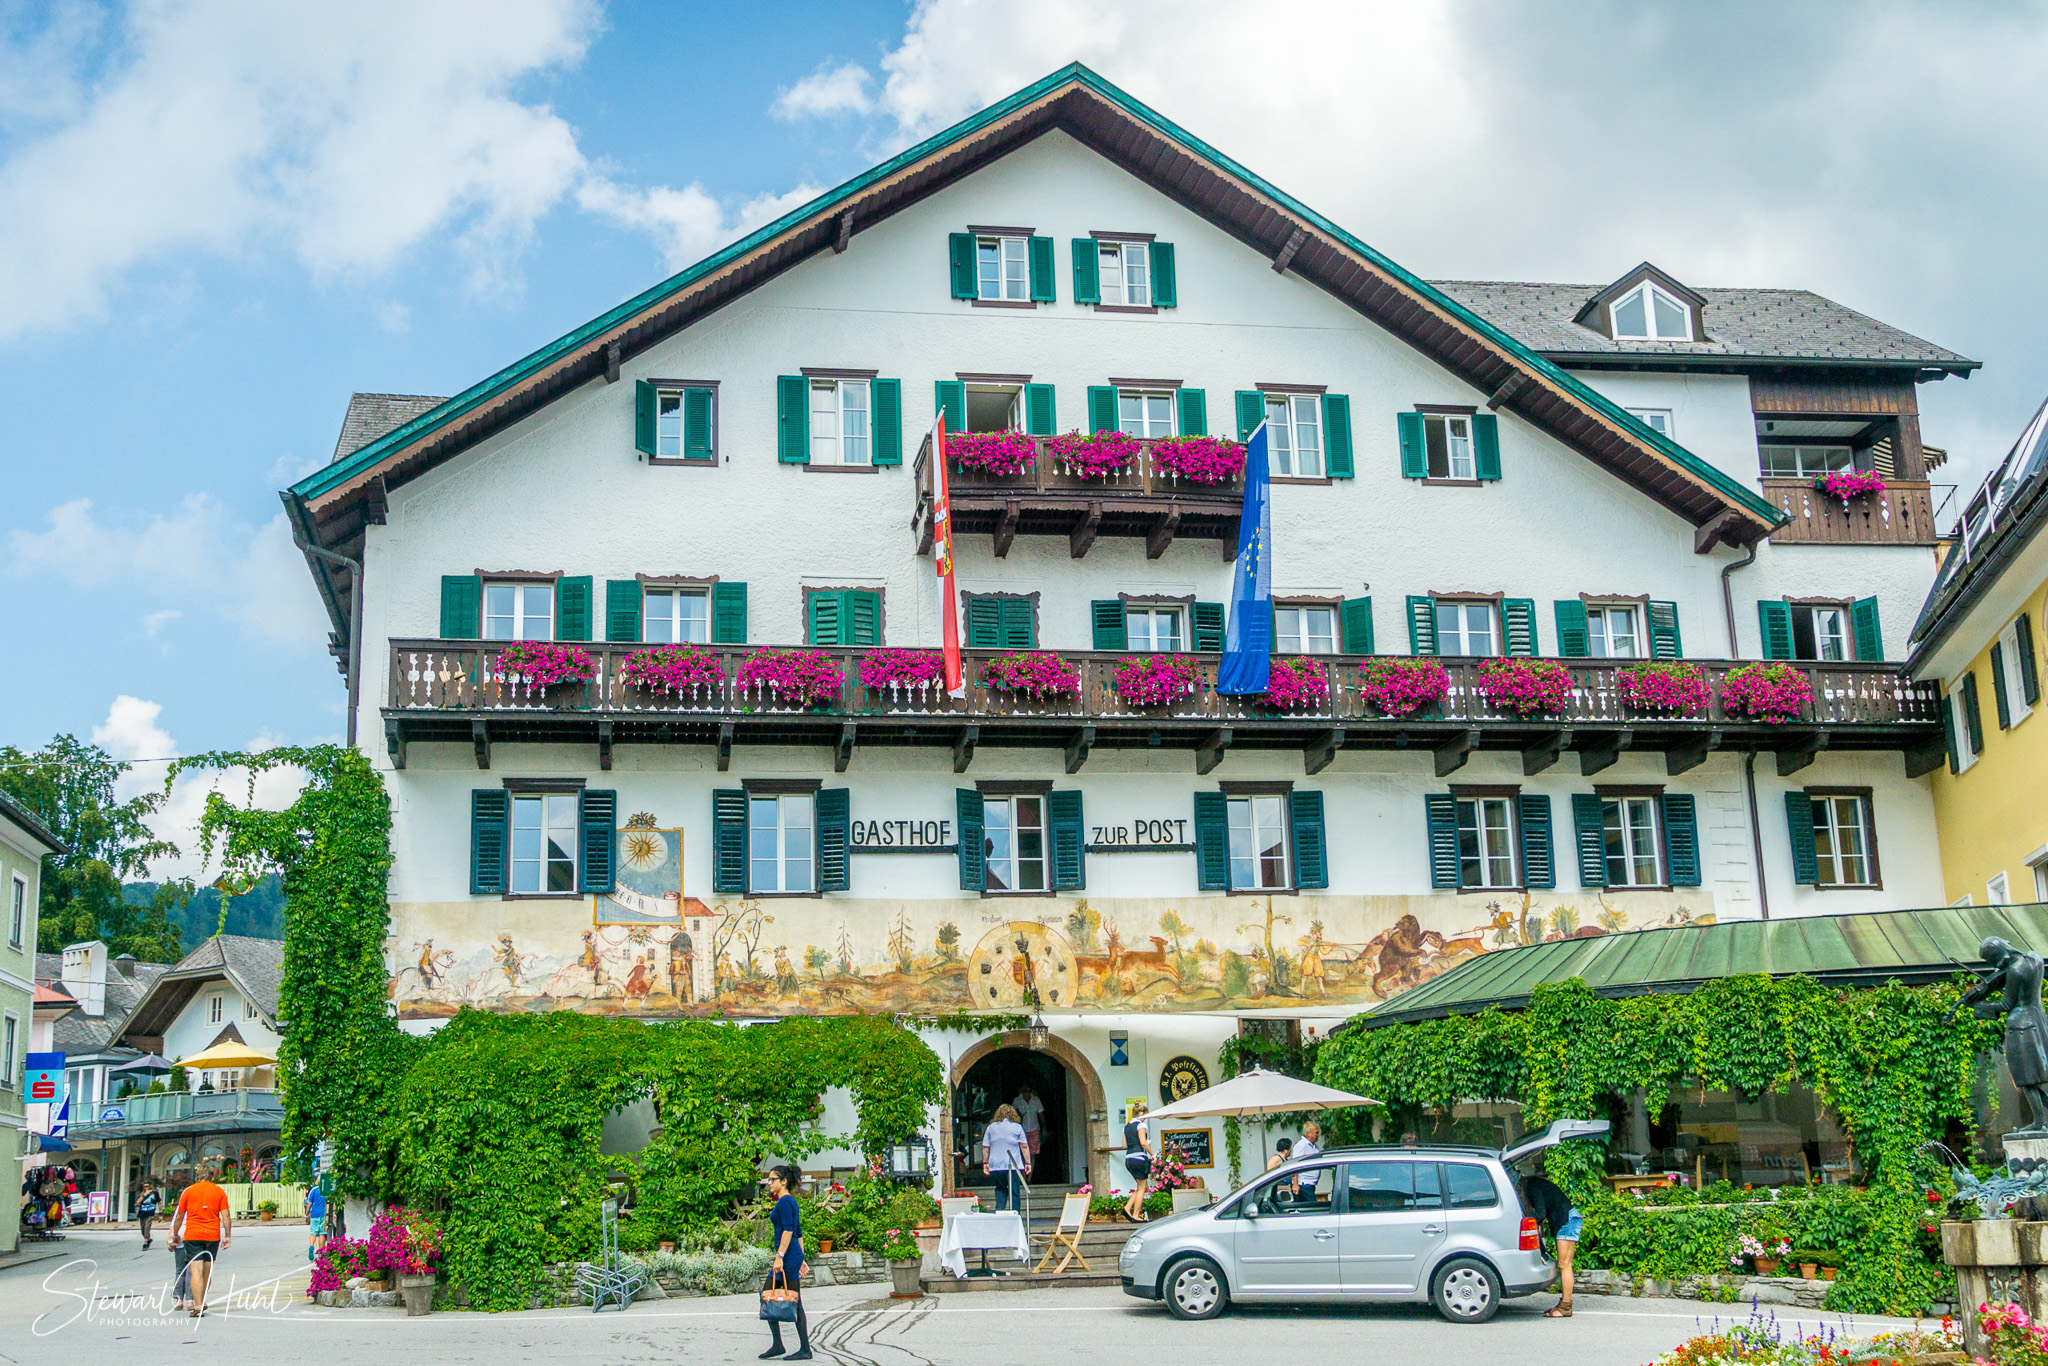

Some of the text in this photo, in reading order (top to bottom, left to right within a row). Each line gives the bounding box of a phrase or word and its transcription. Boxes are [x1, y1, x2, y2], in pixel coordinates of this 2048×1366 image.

[851, 819, 1187, 846] GASTHOF ZUR POST
